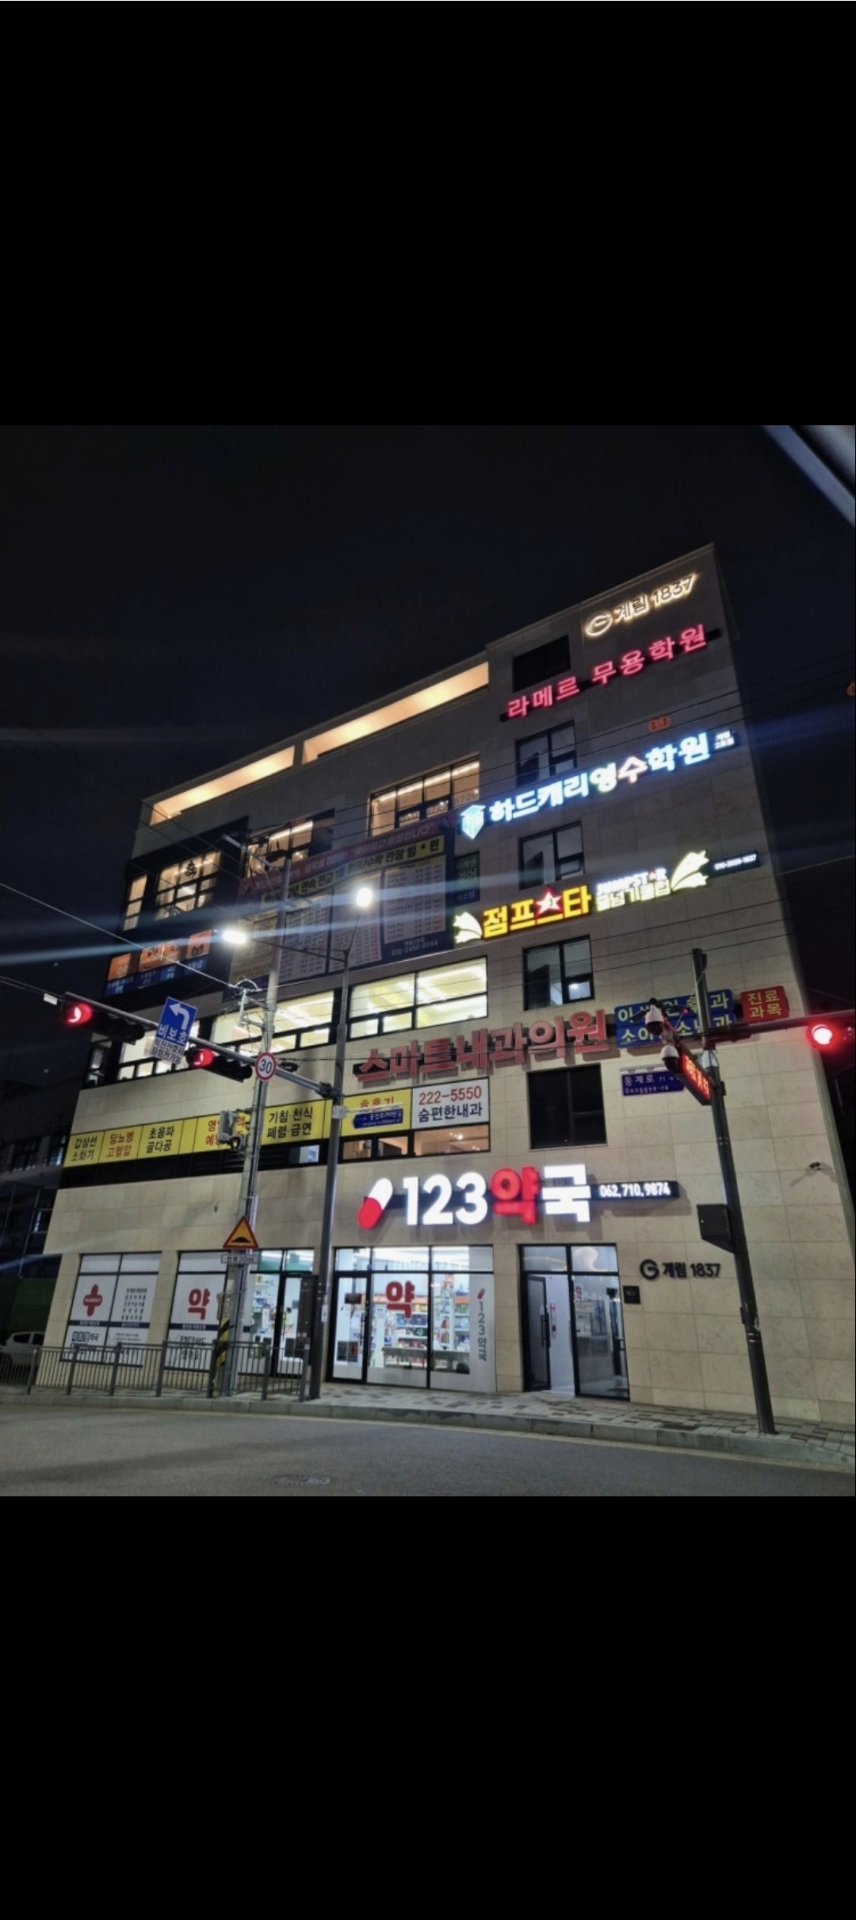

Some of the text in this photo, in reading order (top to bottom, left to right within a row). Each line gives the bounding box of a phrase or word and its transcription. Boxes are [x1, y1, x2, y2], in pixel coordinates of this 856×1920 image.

[614, 594, 649, 622] 계림
[651, 573, 698, 607] 1837
[508, 623, 707, 719] 라메르 무용학원
[488, 732, 711, 823] 하드캐리영수학원
[618, 993, 729, 1022] 이인후과
[748, 988, 780, 1006] 진료
[749, 1003, 782, 1020] 과목
[158, 1024, 187, 1045] 비보호
[357, 1008, 609, 1082] 스마트내과의원
[258, 1059, 272, 1075] 30
[624, 1074, 655, 1087] 동계로
[419, 1085, 482, 1106] 222-5550
[418, 1101, 484, 1123] 숨편한내과
[148, 1125, 175, 1139] 초음파
[74, 1136, 98, 1150] 갑상선
[107, 1145, 132, 1158] 고혈압
[146, 1139, 172, 1154] 골다공
[71, 1150, 95, 1162] 소화기
[402, 1163, 592, 1226] 123약국
[662, 1261, 687, 1279] 계림
[690, 1263, 721, 1278] 1837
[188, 1288, 211, 1320] 약
[386, 1281, 415, 1319] 약
[477, 1301, 487, 1362] 123약국
